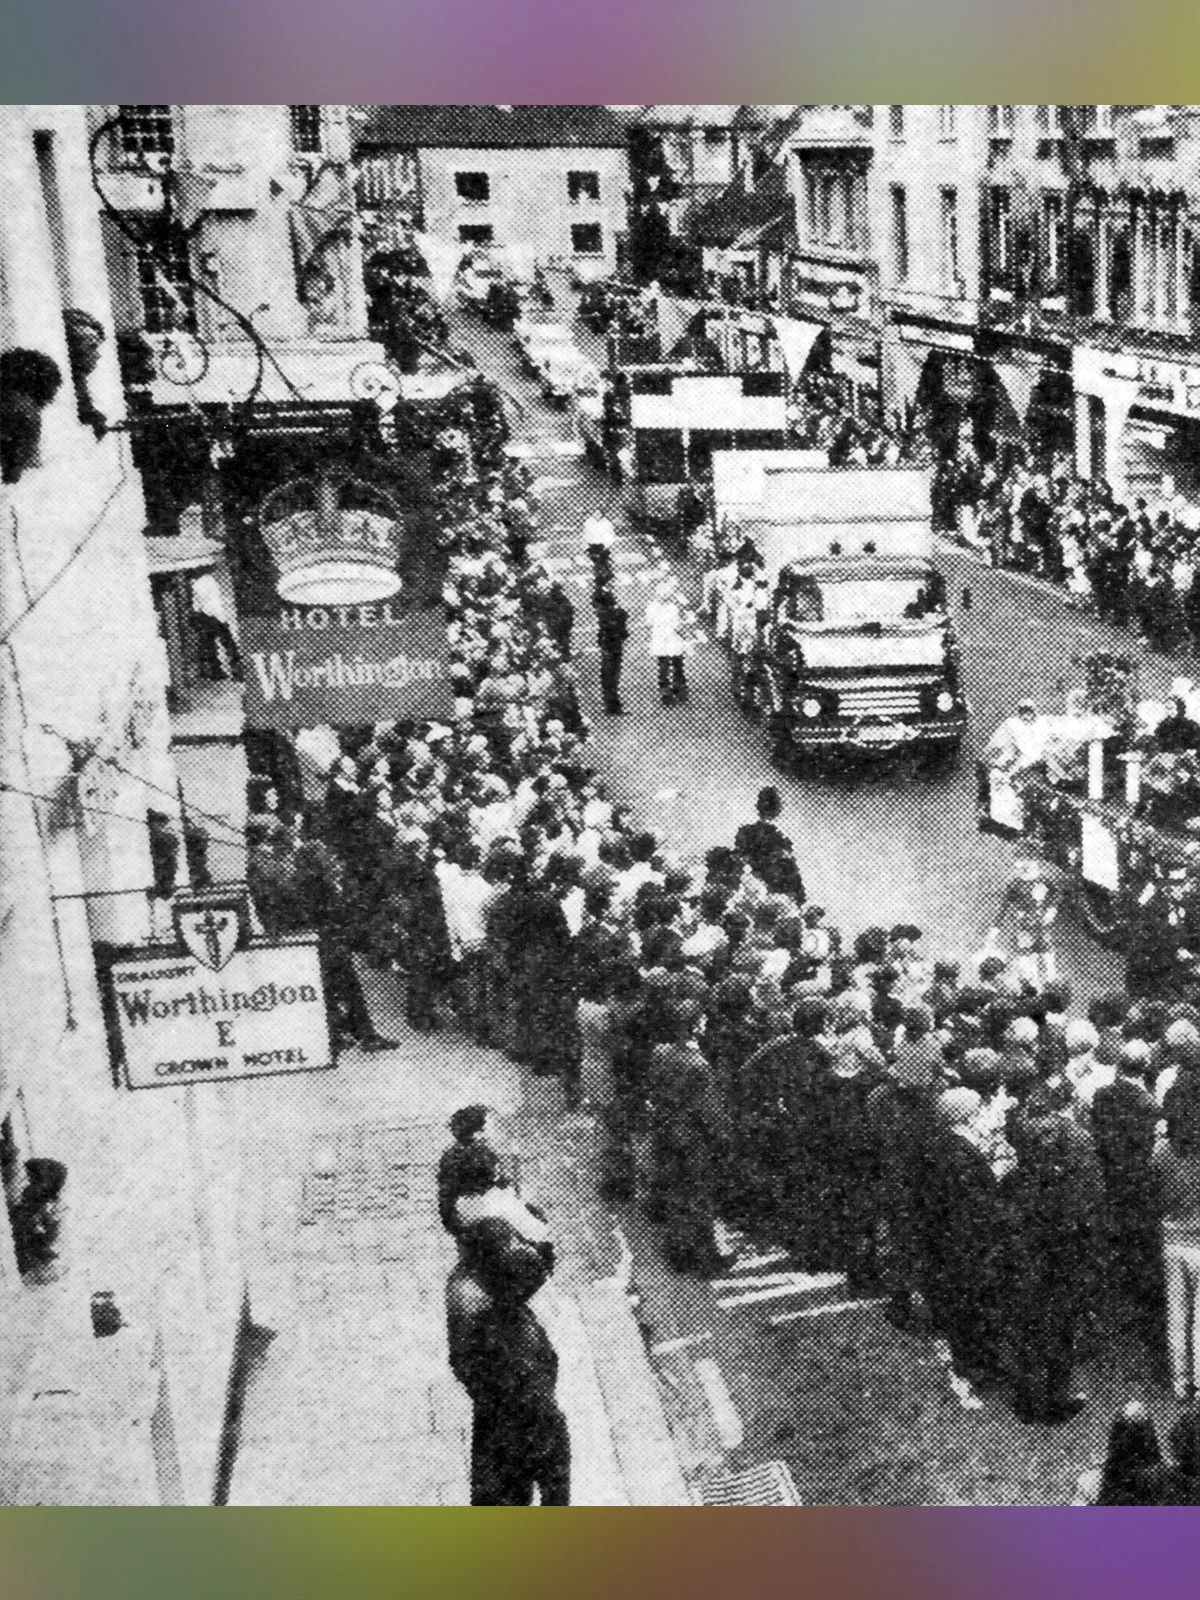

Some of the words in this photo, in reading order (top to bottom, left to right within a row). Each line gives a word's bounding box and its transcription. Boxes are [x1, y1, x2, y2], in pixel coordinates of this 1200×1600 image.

[280, 604, 402, 631] HOTEL
[117, 982, 319, 1029] Worthington
[215, 1020, 237, 1048] E
[154, 1057, 230, 1077] CROWN
[242, 1048, 308, 1067] HOTEL
